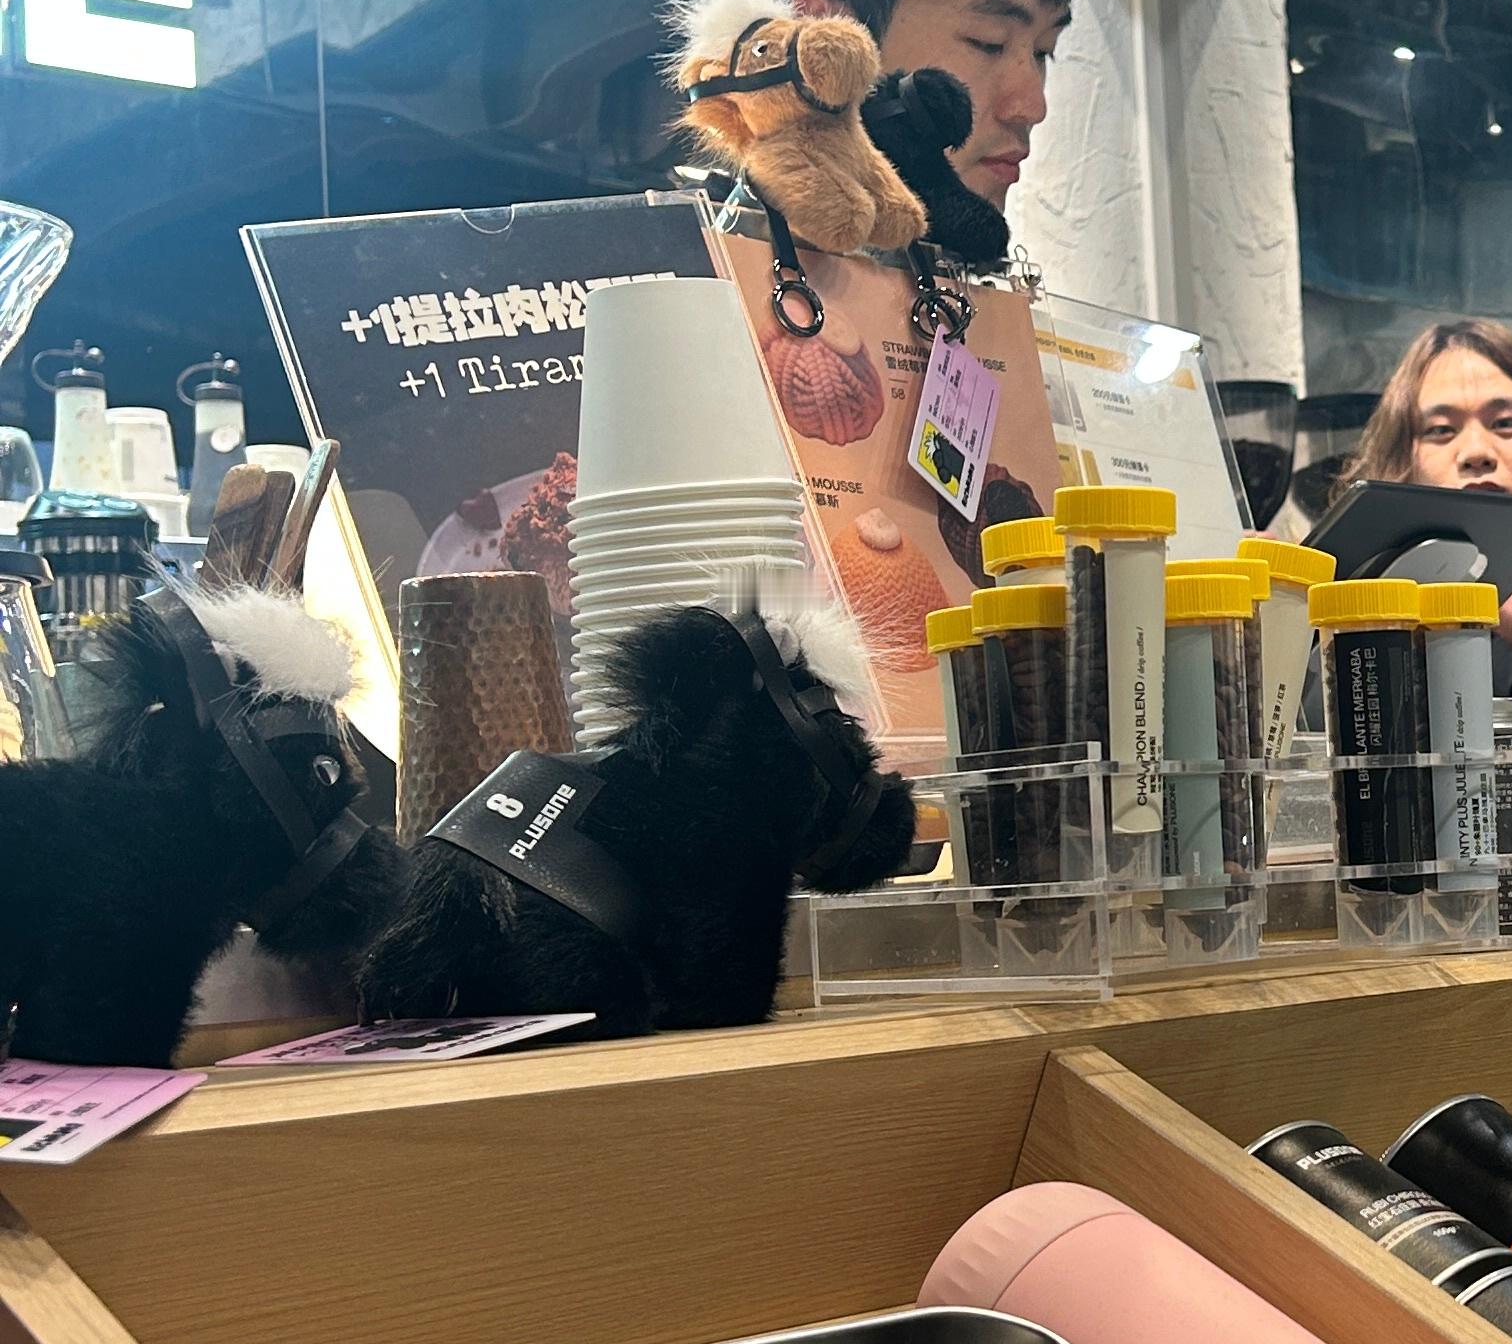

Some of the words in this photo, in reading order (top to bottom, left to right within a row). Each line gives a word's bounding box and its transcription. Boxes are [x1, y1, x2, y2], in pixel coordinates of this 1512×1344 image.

[400, 362, 446, 398] +1
[891, 388, 905, 400] 58
[812, 477, 864, 494] MOUSSE
[1350, 647, 1365, 711] MERKABA
[1134, 681, 1146, 728] BLEND
[486, 793, 524, 819] 8
[1360, 785, 1371, 800] EL
[1457, 795, 1469, 828] PLUS
